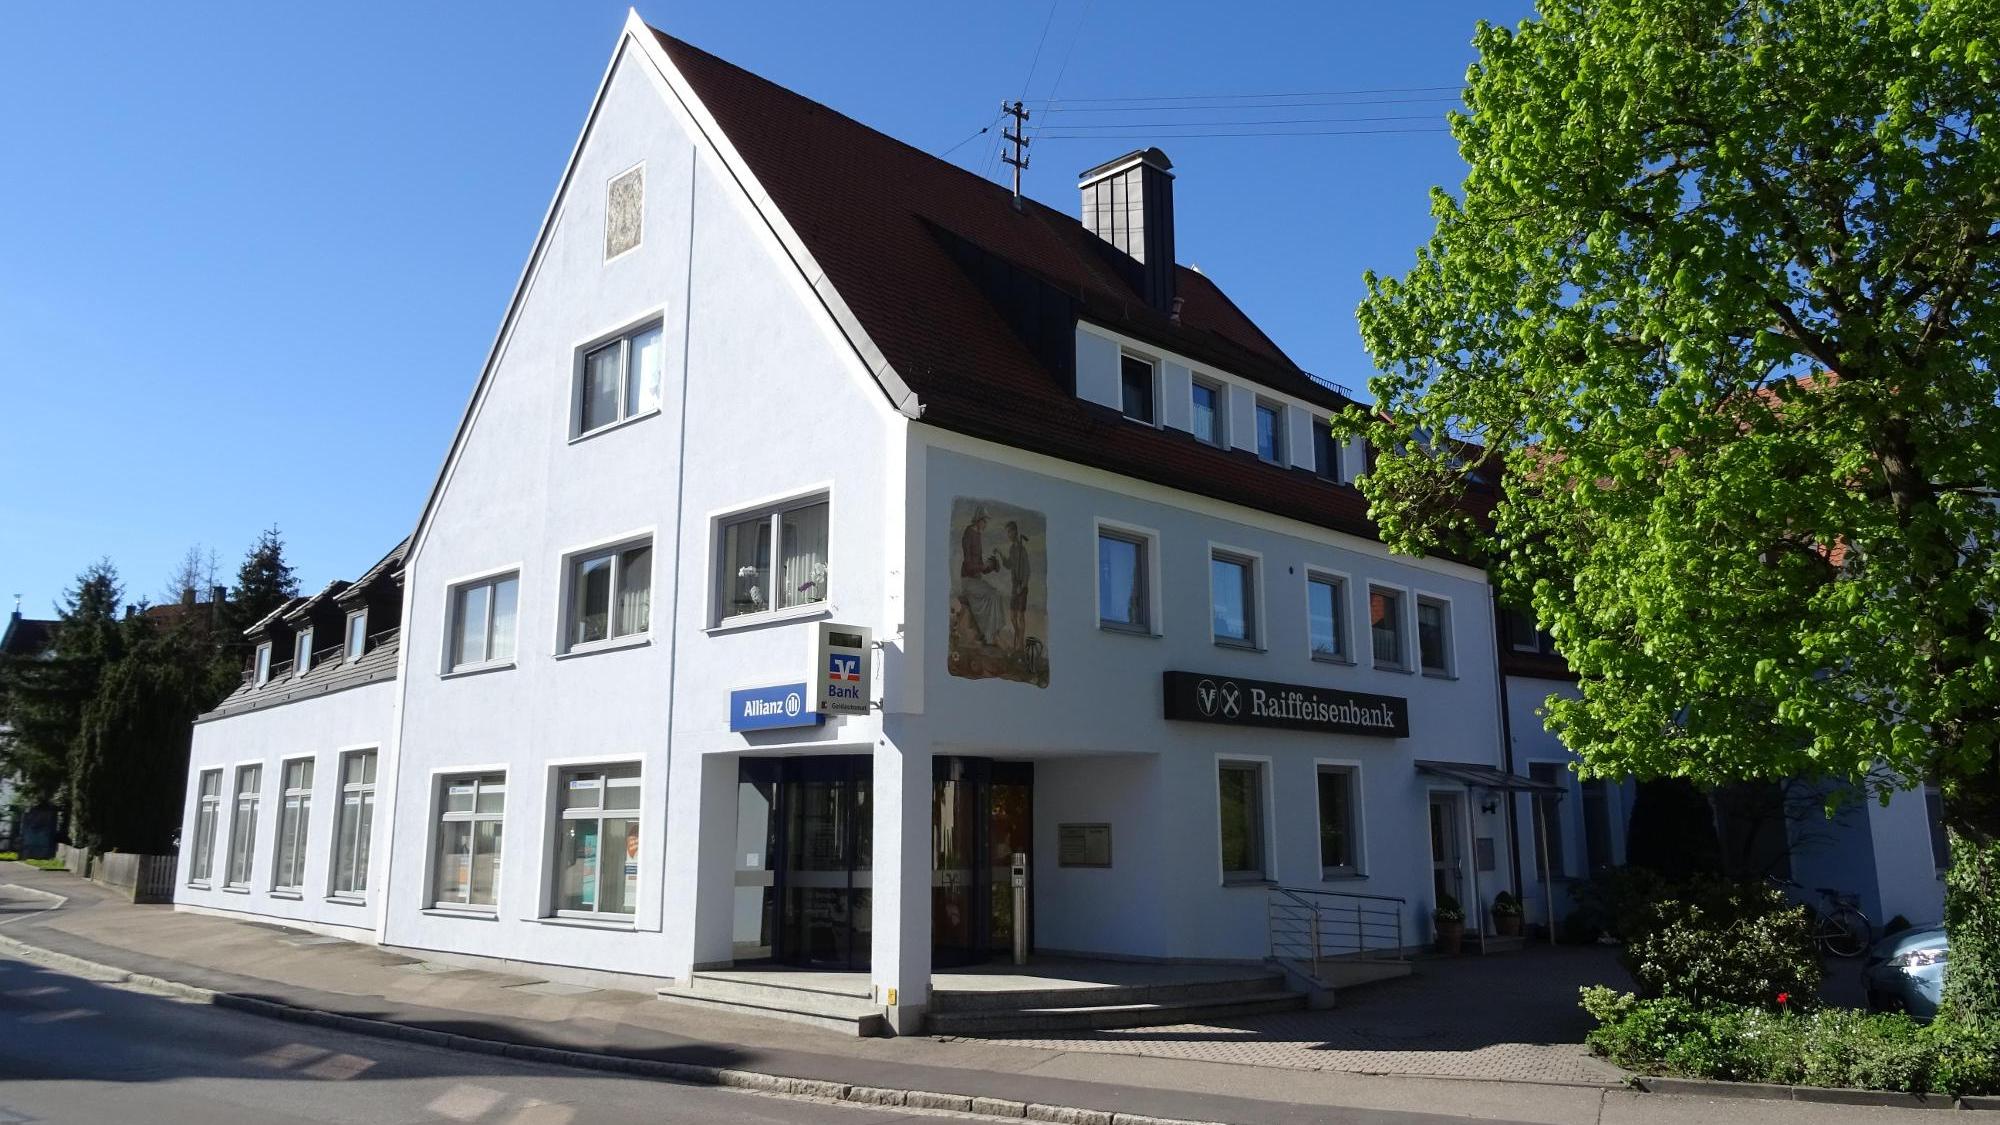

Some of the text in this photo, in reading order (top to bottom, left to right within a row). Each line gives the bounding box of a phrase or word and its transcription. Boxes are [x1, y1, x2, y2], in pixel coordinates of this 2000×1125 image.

[829, 684, 859, 699] Bank
[744, 699, 783, 717] Allianz
[1250, 688, 1395, 728] Raiffeisenbank
